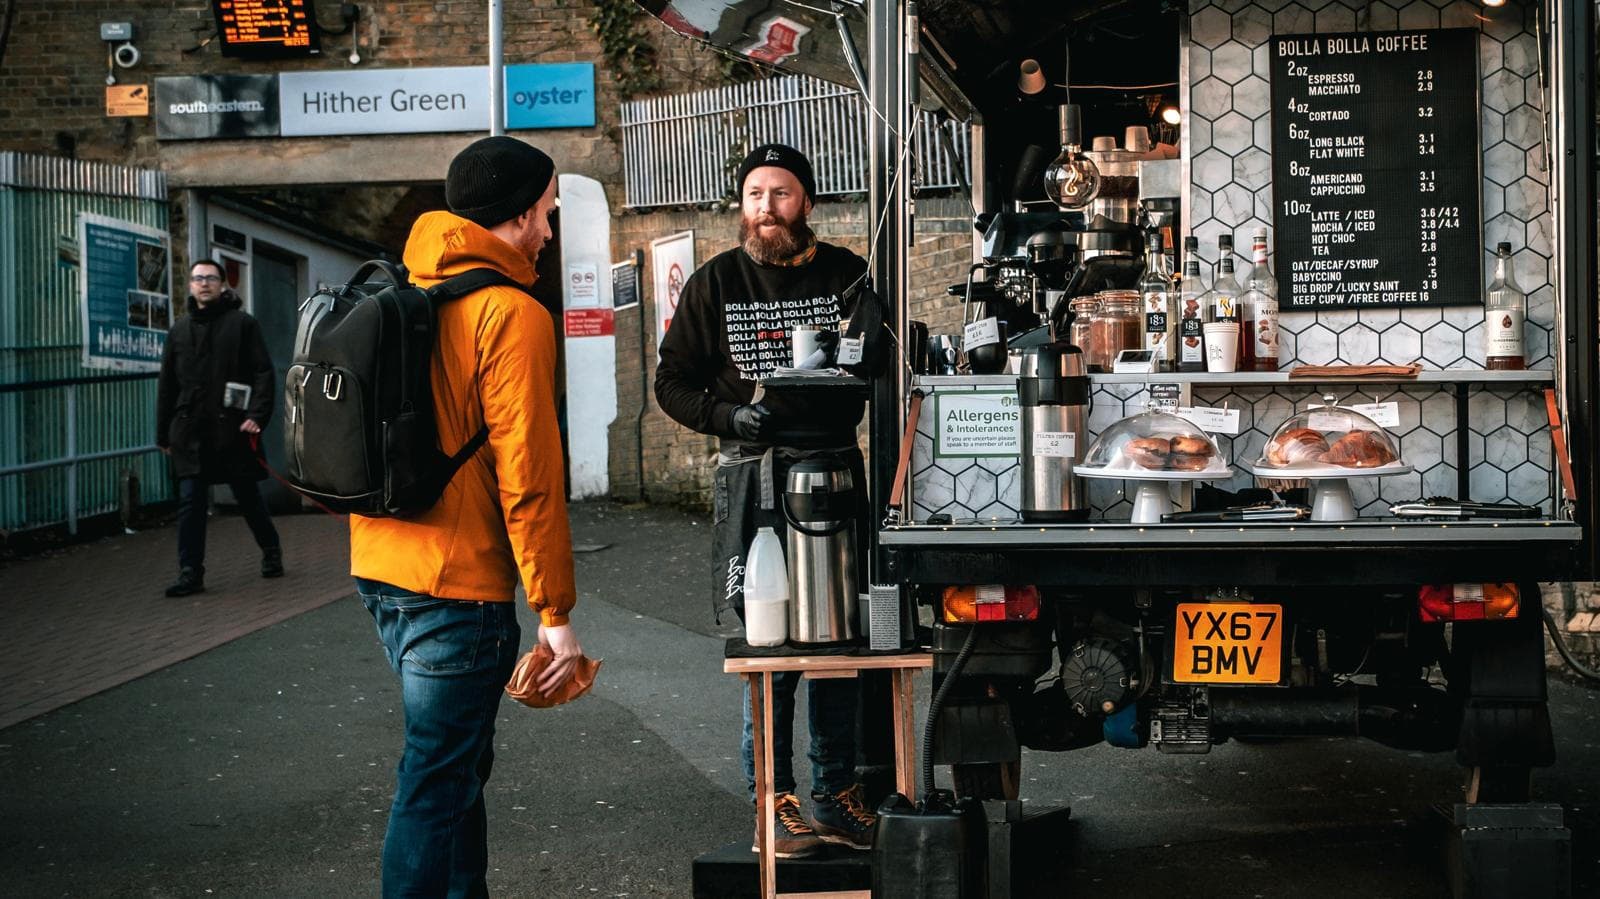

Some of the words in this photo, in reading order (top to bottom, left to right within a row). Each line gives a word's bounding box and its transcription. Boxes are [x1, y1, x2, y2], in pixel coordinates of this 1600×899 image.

[1279, 40, 1320, 56] BOLLA
[1328, 37, 1369, 55] BOLLA
[1377, 35, 1427, 52] COFFEE
[1308, 73, 1354, 84] ESPRESSO
[1418, 70, 1432, 80] 2.8
[1309, 84, 1360, 96] MACCHIATO
[1418, 82, 1432, 92] 2.9
[302, 91, 381, 115] Hither
[390, 88, 467, 114] Green
[513, 86, 583, 110] oyster
[1309, 111, 1350, 121] CORTADO
[1418, 108, 1433, 117] 3.2
[1310, 137, 1333, 148] LONG
[1335, 136, 1364, 146] BLACK
[1419, 134, 1434, 143] 3.1
[1310, 149, 1332, 159] FLAT
[1336, 148, 1365, 158] WHITE
[1419, 145, 1435, 155] 3.4
[1311, 174, 1362, 185] AMERICANO
[1420, 171, 1435, 181] 3.1
[1311, 185, 1365, 196] CAPPUCCINO
[1420, 182, 1435, 192] 3.5
[1311, 211, 1340, 222] LATTE
[1354, 210, 1375, 220] ICED
[1421, 208, 1436, 218] 3.6
[1312, 222, 1343, 233] MOCHA
[1354, 221, 1375, 231] ICED
[1312, 234, 1328, 244] HOT
[1332, 233, 1355, 243] CHOC
[1422, 231, 1436, 241] 3.8
[1313, 246, 1329, 256] TEA
[1422, 242, 1436, 252] 2.8
[1293, 271, 1342, 282] BABYCCINO
[1293, 284, 1306, 294] BIG
[1310, 282, 1333, 293] DROP
[1373, 281, 1400, 291] SAINT
[725, 303, 754, 312] BOLLA
[754, 301, 780, 310] BOLLA
[782, 299, 811, 309] BOLLA
[812, 294, 838, 305] BOLLA
[1293, 294, 1316, 305] KEEP
[1382, 292, 1417, 302] COFFEE
[726, 312, 756, 322] BOLLA
[756, 311, 781, 320] BOLLA
[783, 308, 812, 318] BOLLA
[814, 304, 840, 315] BOLLA
[727, 323, 756, 332] BOLLA
[784, 319, 813, 328] BOLLA
[815, 314, 841, 324] BOLLA
[728, 332, 756, 342] BOLLA
[729, 342, 756, 352] BOLLA
[758, 341, 784, 350] BOLLA
[759, 351, 786, 360] BOLLA
[946, 410, 1018, 424] Allergens
[956, 424, 1014, 432] Intolerances
[1182, 612, 1277, 640] YX67
[1192, 646, 1263, 675] BMV
